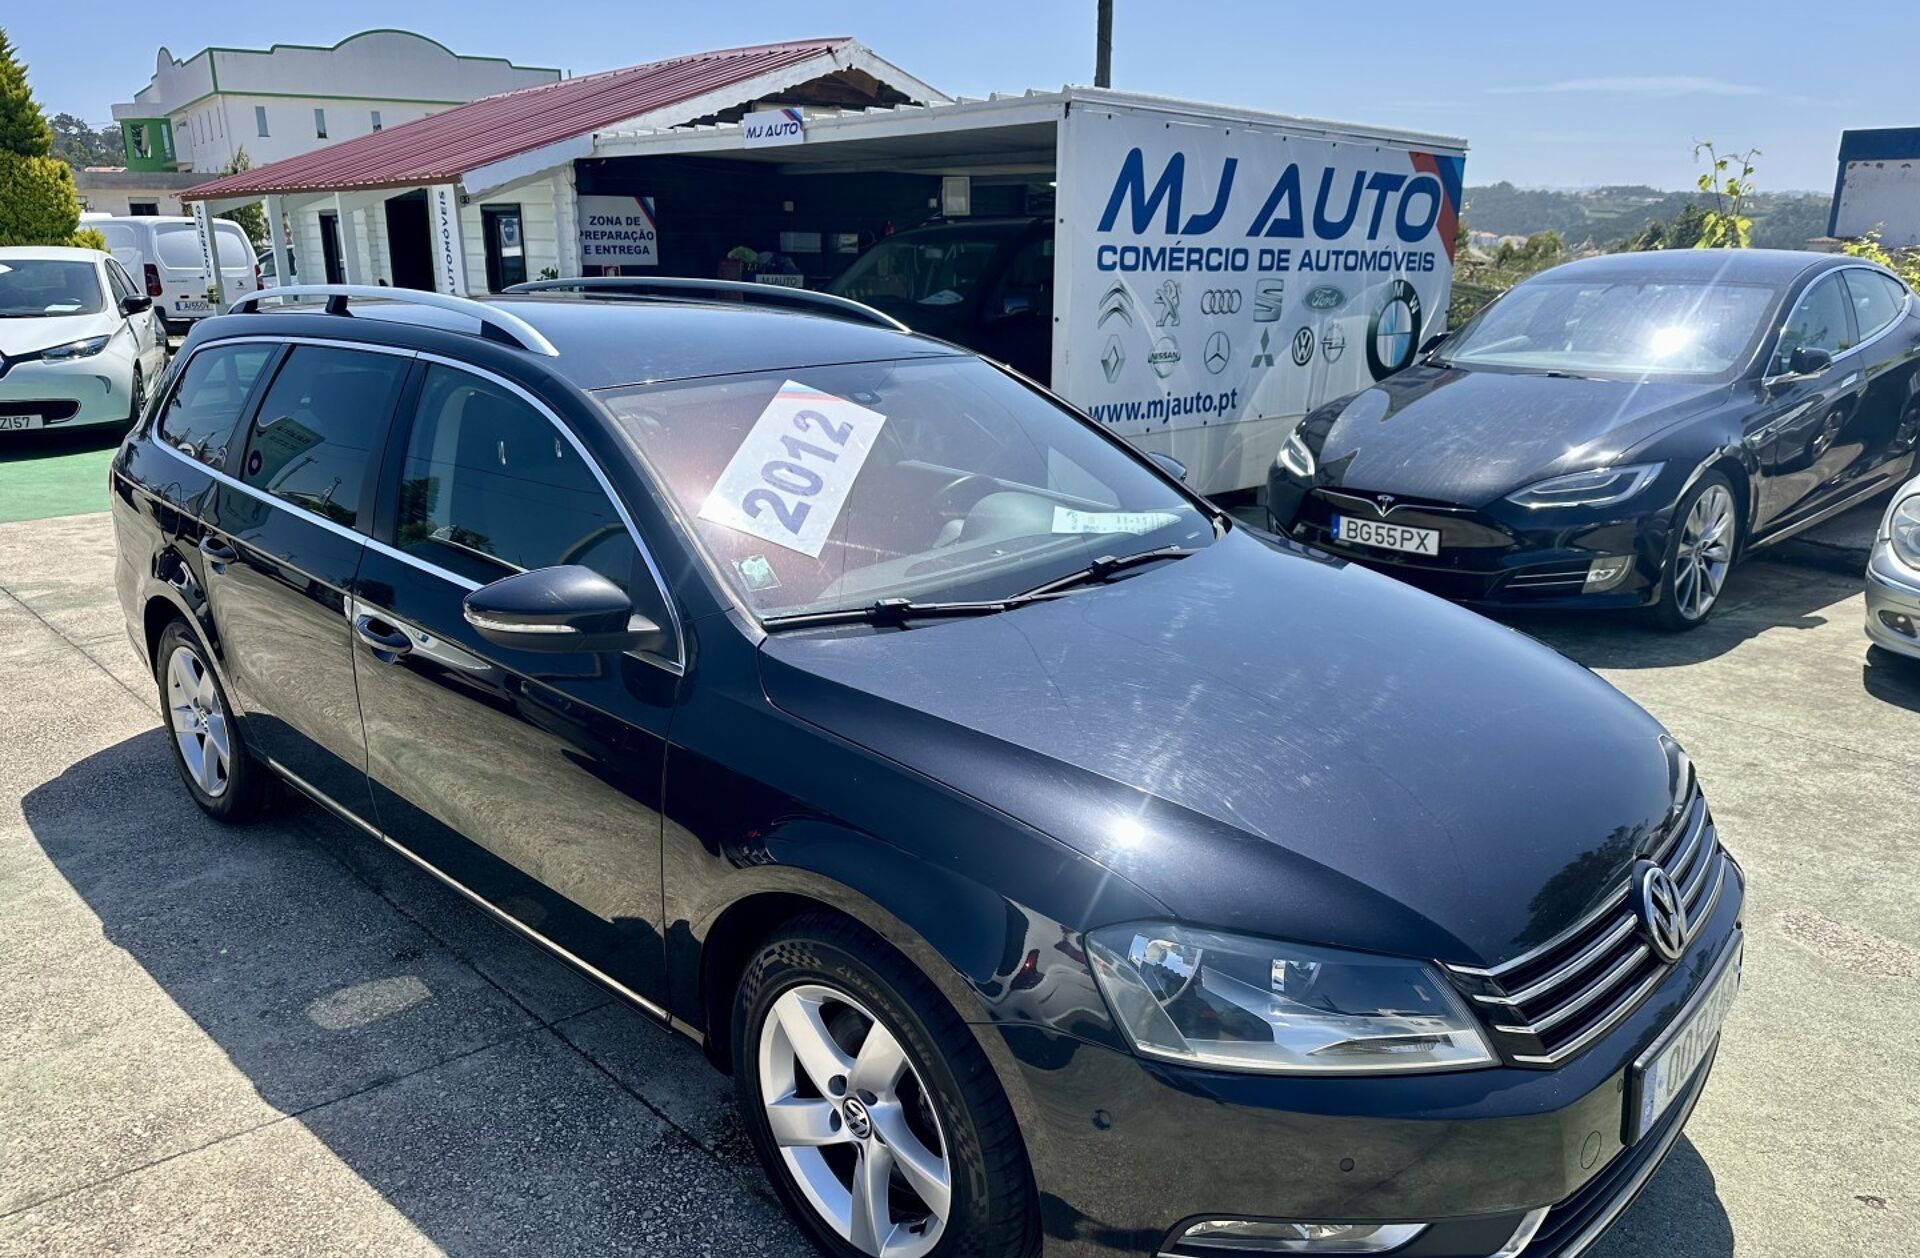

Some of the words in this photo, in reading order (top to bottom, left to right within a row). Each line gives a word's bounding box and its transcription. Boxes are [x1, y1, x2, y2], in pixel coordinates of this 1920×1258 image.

[746, 125, 763, 139] MJ
[765, 122, 798, 137] AUTO
[1096, 146, 1239, 235] MJ
[1245, 162, 1441, 243] AUTO
[589, 215, 622, 226] ZONA
[625, 216, 641, 226] DE
[584, 244, 592, 255] E
[595, 244, 650, 255] ENTREGA
[1096, 240, 1249, 273] COMÉRCIO
[1257, 248, 1291, 272] DE
[1297, 245, 1436, 273] AUTOMÓVEIS
[1311, 289, 1339, 309] Ford
[1151, 351, 1179, 361] NISSAN
[1088, 387, 1238, 425] www.mjauto.pt
[742, 409, 855, 536] 2012
[1346, 520, 1431, 553] BG55PX
